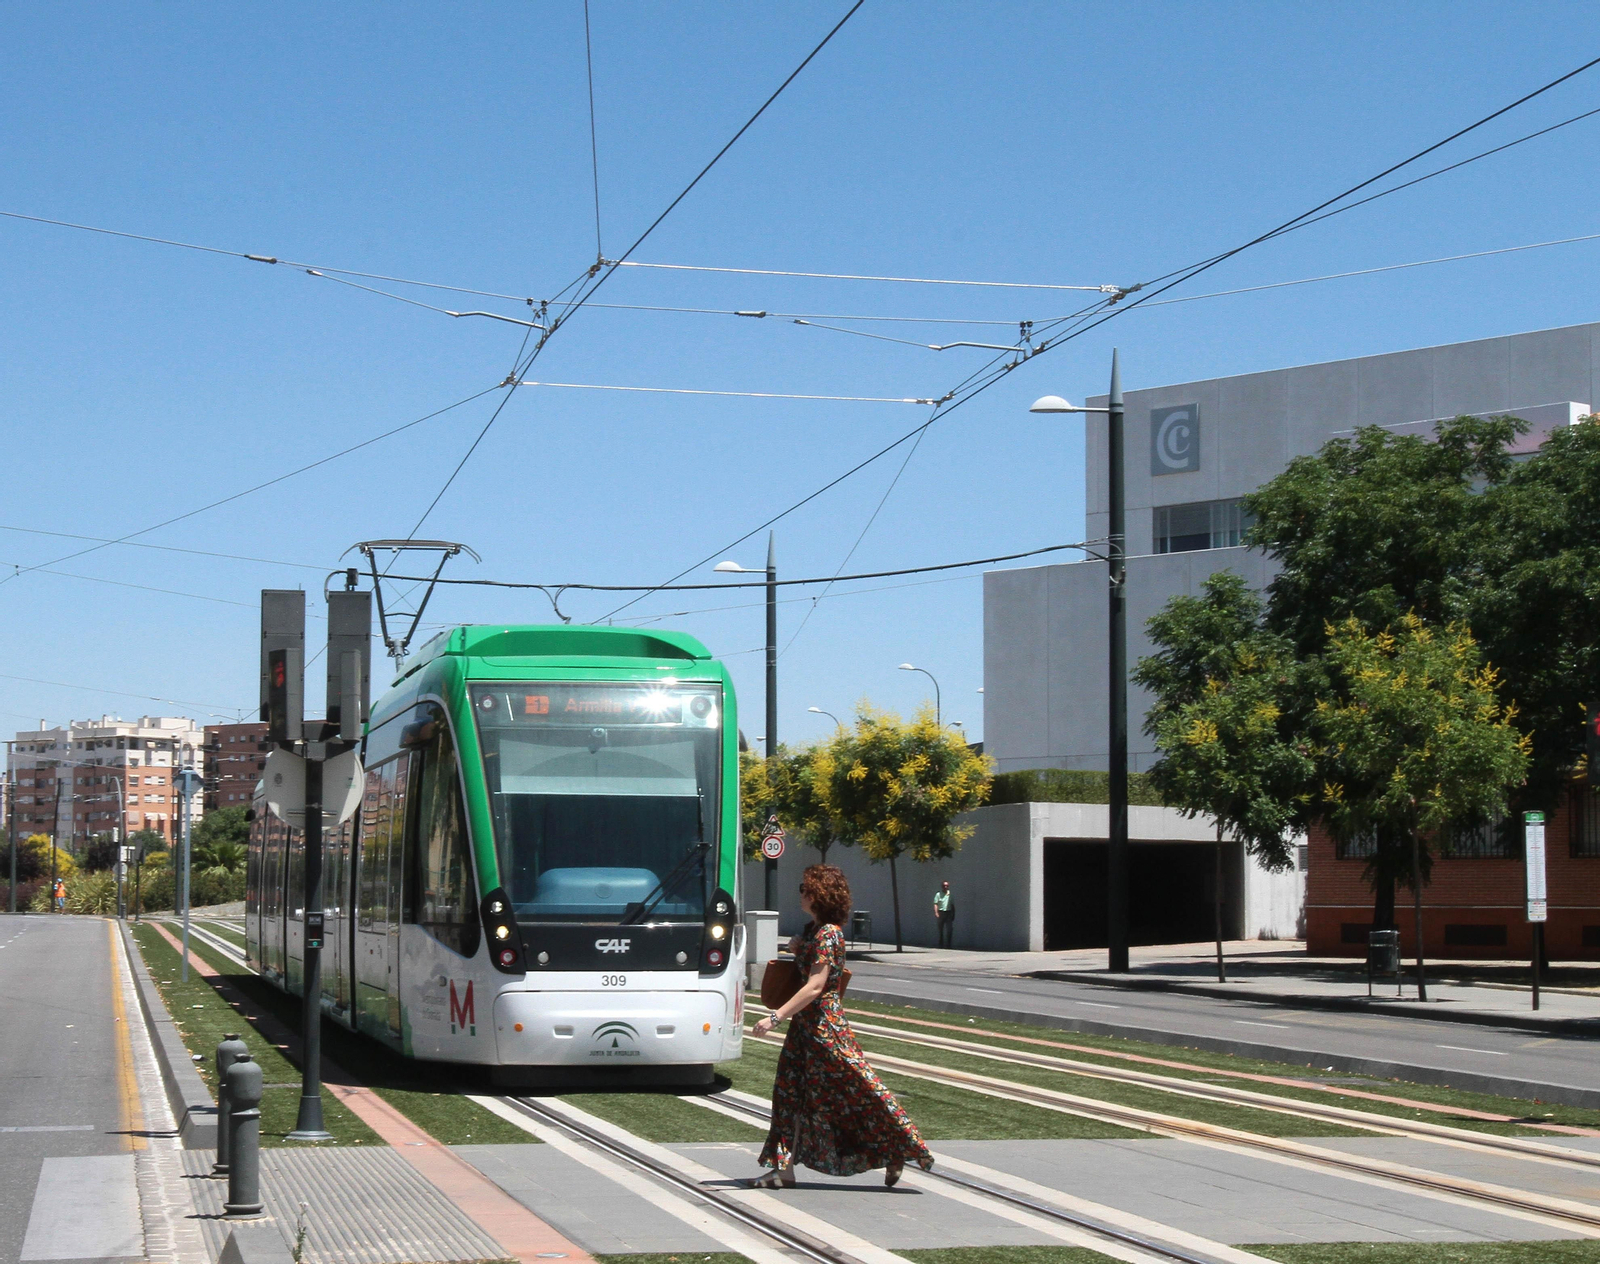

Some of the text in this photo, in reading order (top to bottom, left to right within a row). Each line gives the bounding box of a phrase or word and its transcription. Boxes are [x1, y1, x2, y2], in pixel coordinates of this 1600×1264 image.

[767, 842, 780, 851] 30
[594, 938, 631, 954] CAF
[601, 974, 627, 987] 309
[449, 978, 476, 1036] M
